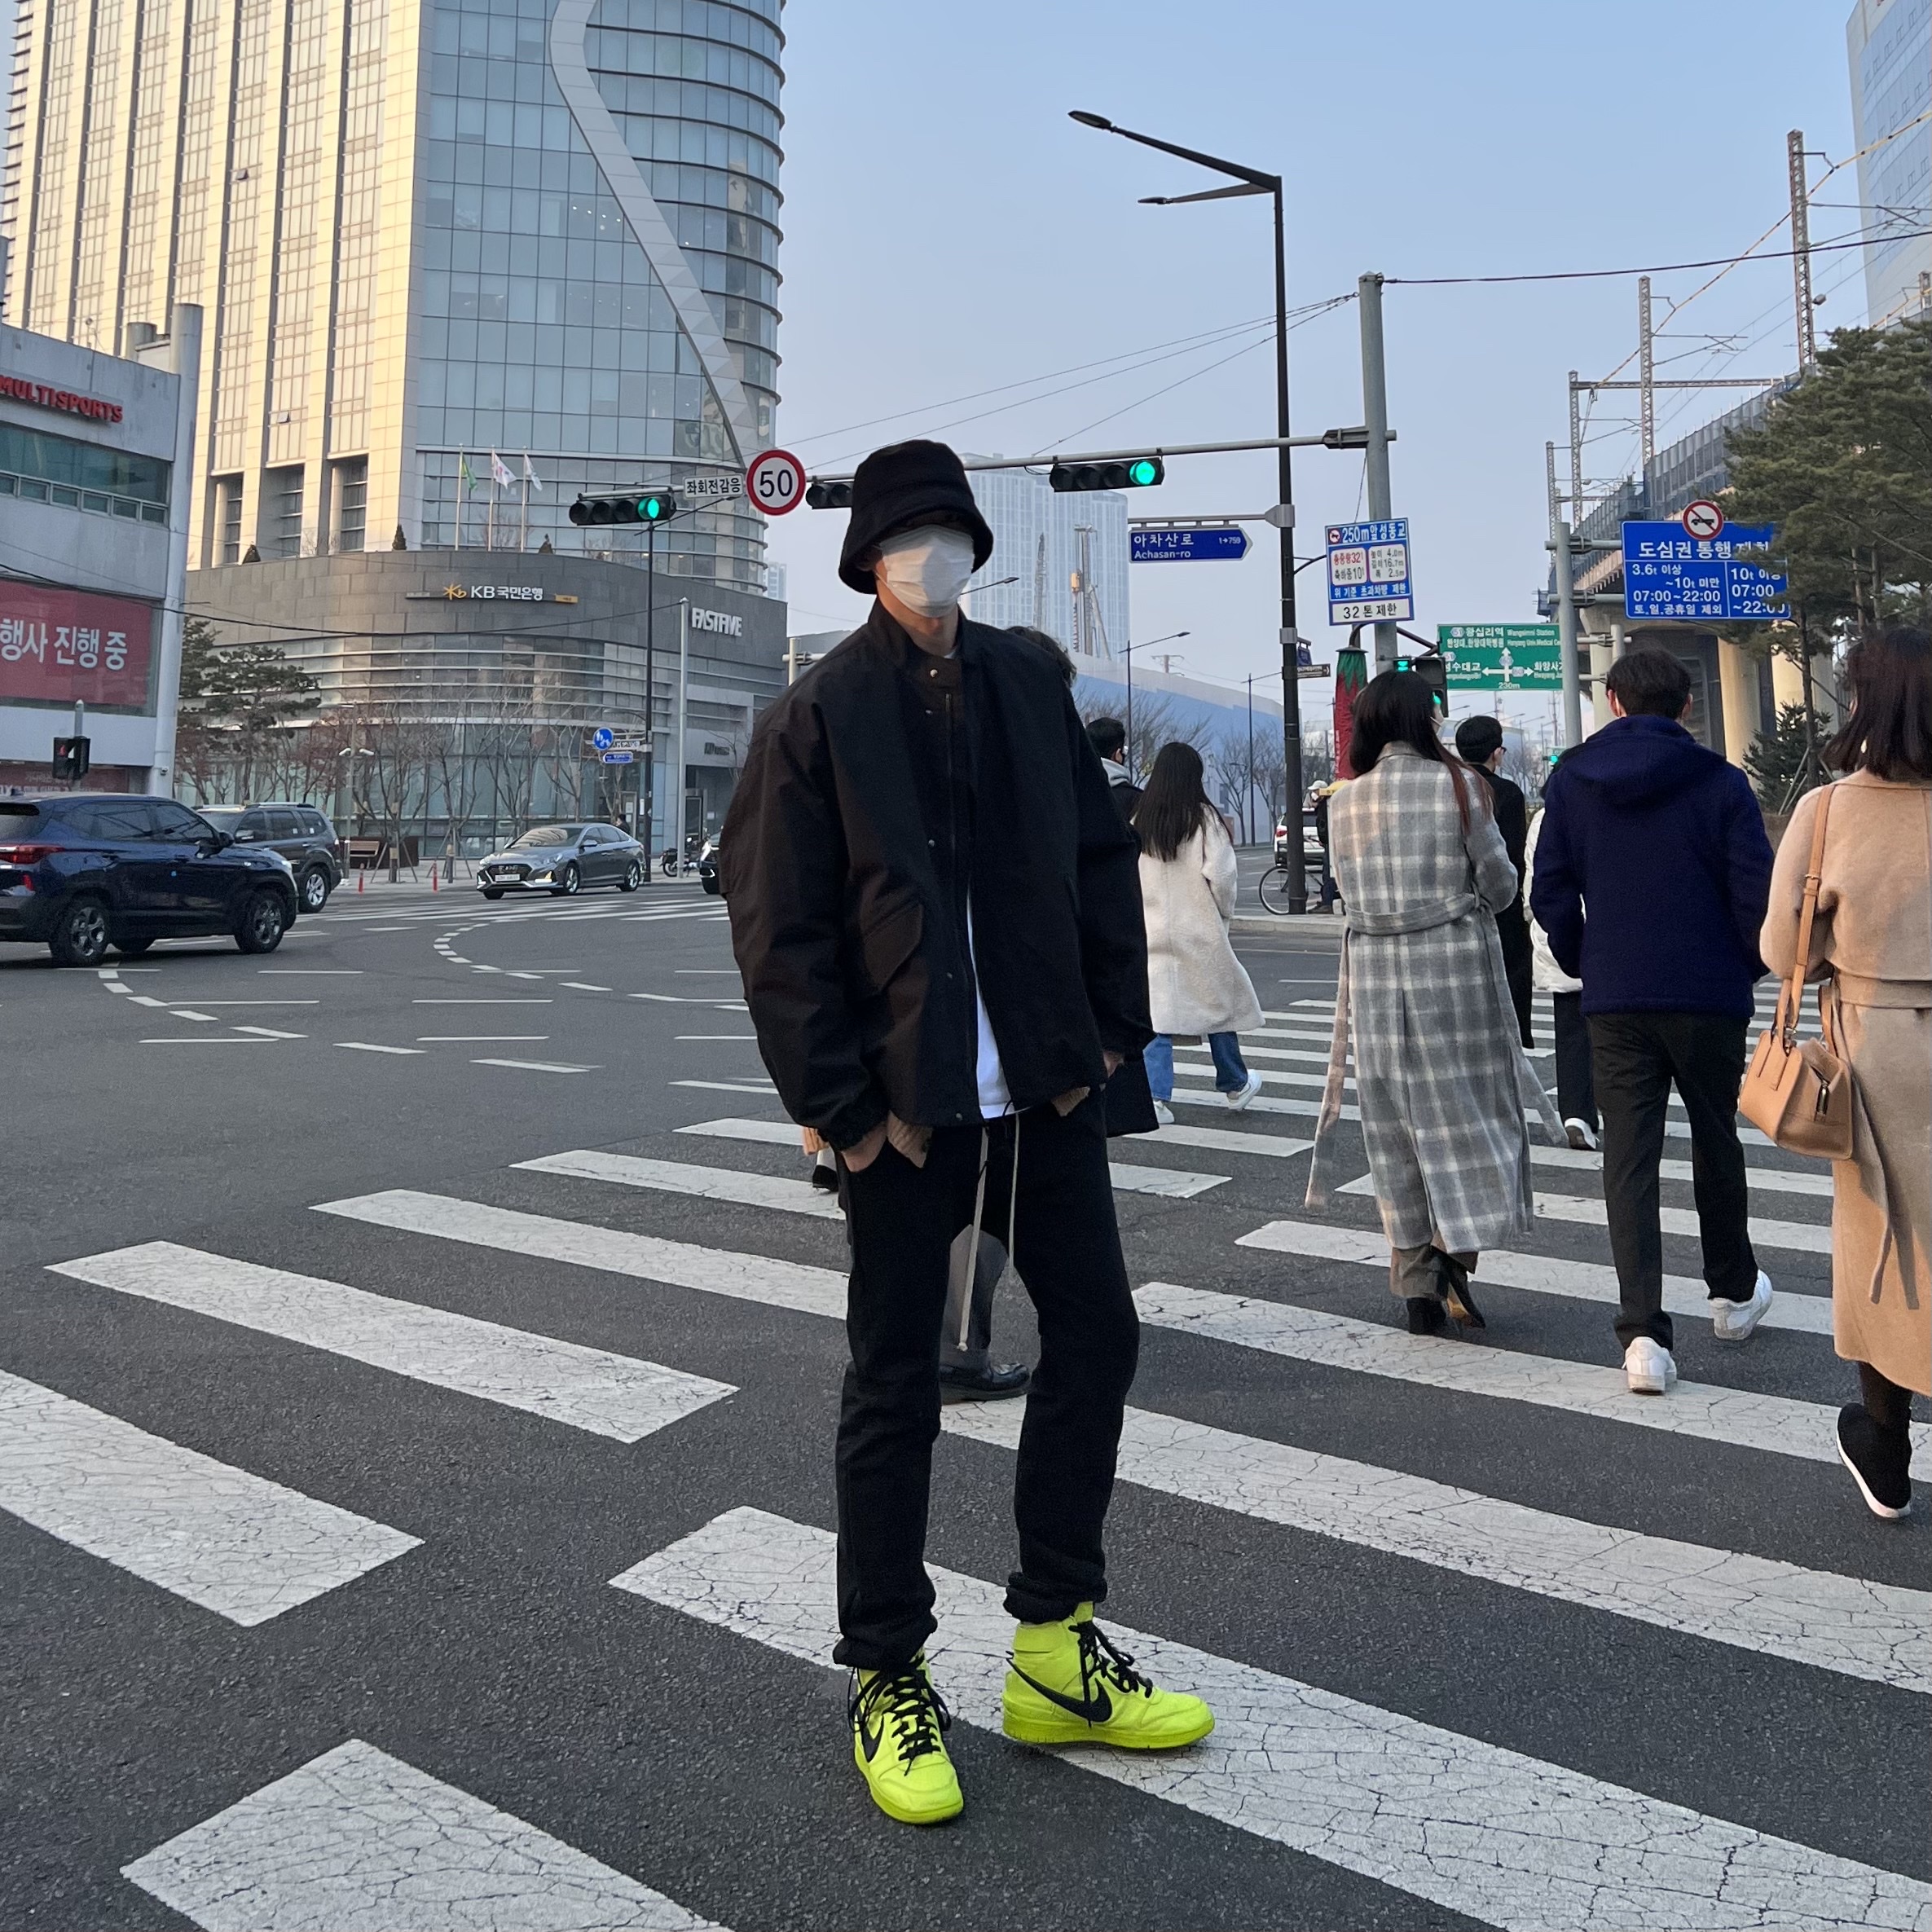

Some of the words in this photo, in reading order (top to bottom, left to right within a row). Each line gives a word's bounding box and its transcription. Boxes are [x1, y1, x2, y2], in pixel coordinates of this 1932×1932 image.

[0, 375, 124, 424] MULTISPORTS
[686, 477, 742, 495] 좌회전감응
[759, 469, 793, 498] 50
[1133, 533, 1195, 548] 아차산로
[1134, 550, 1191, 560] Achasan-ro
[1639, 541, 1692, 559] 도심권
[1696, 541, 1732, 559] 통행
[1632, 564, 1657, 575] 3.6t
[1661, 564, 1682, 575] 이상
[1731, 568, 1754, 580] 10t
[1699, 577, 1720, 588] 미만
[1732, 584, 1775, 597] 07:00
[1343, 605, 1360, 619] 32
[1376, 603, 1397, 616] 제한
[1701, 604, 1723, 615] 제외
[1466, 627, 1504, 637] 왕십리역
[0, 618, 49, 663] 행사
[54, 626, 99, 669] 진행
[104, 631, 128, 671] 중
